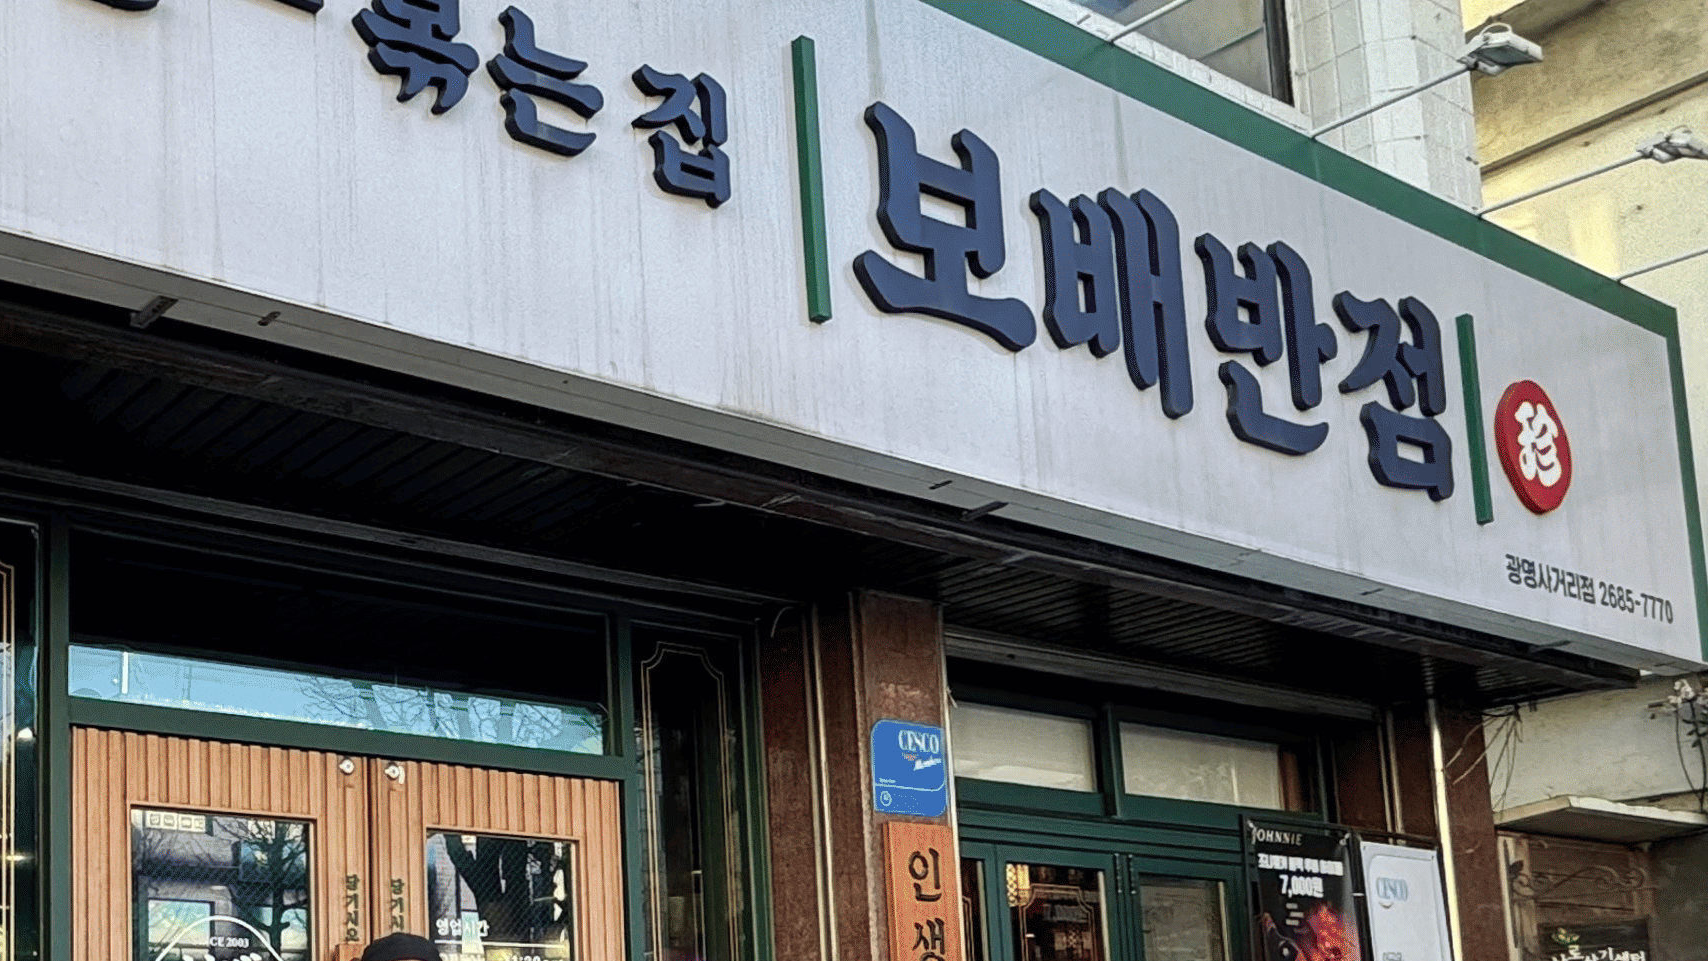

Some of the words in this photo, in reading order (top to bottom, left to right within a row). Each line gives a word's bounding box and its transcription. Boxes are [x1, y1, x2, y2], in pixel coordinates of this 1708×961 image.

[852, 100, 1455, 502] 보배반점
[1505, 553, 1596, 605] 광명사거리점
[1598, 581, 1674, 625] 2685-7770
[1251, 827, 1303, 846] JOHNNIE
[435, 917, 490, 938] 영업시간
[225, 937, 250, 948] 2003
